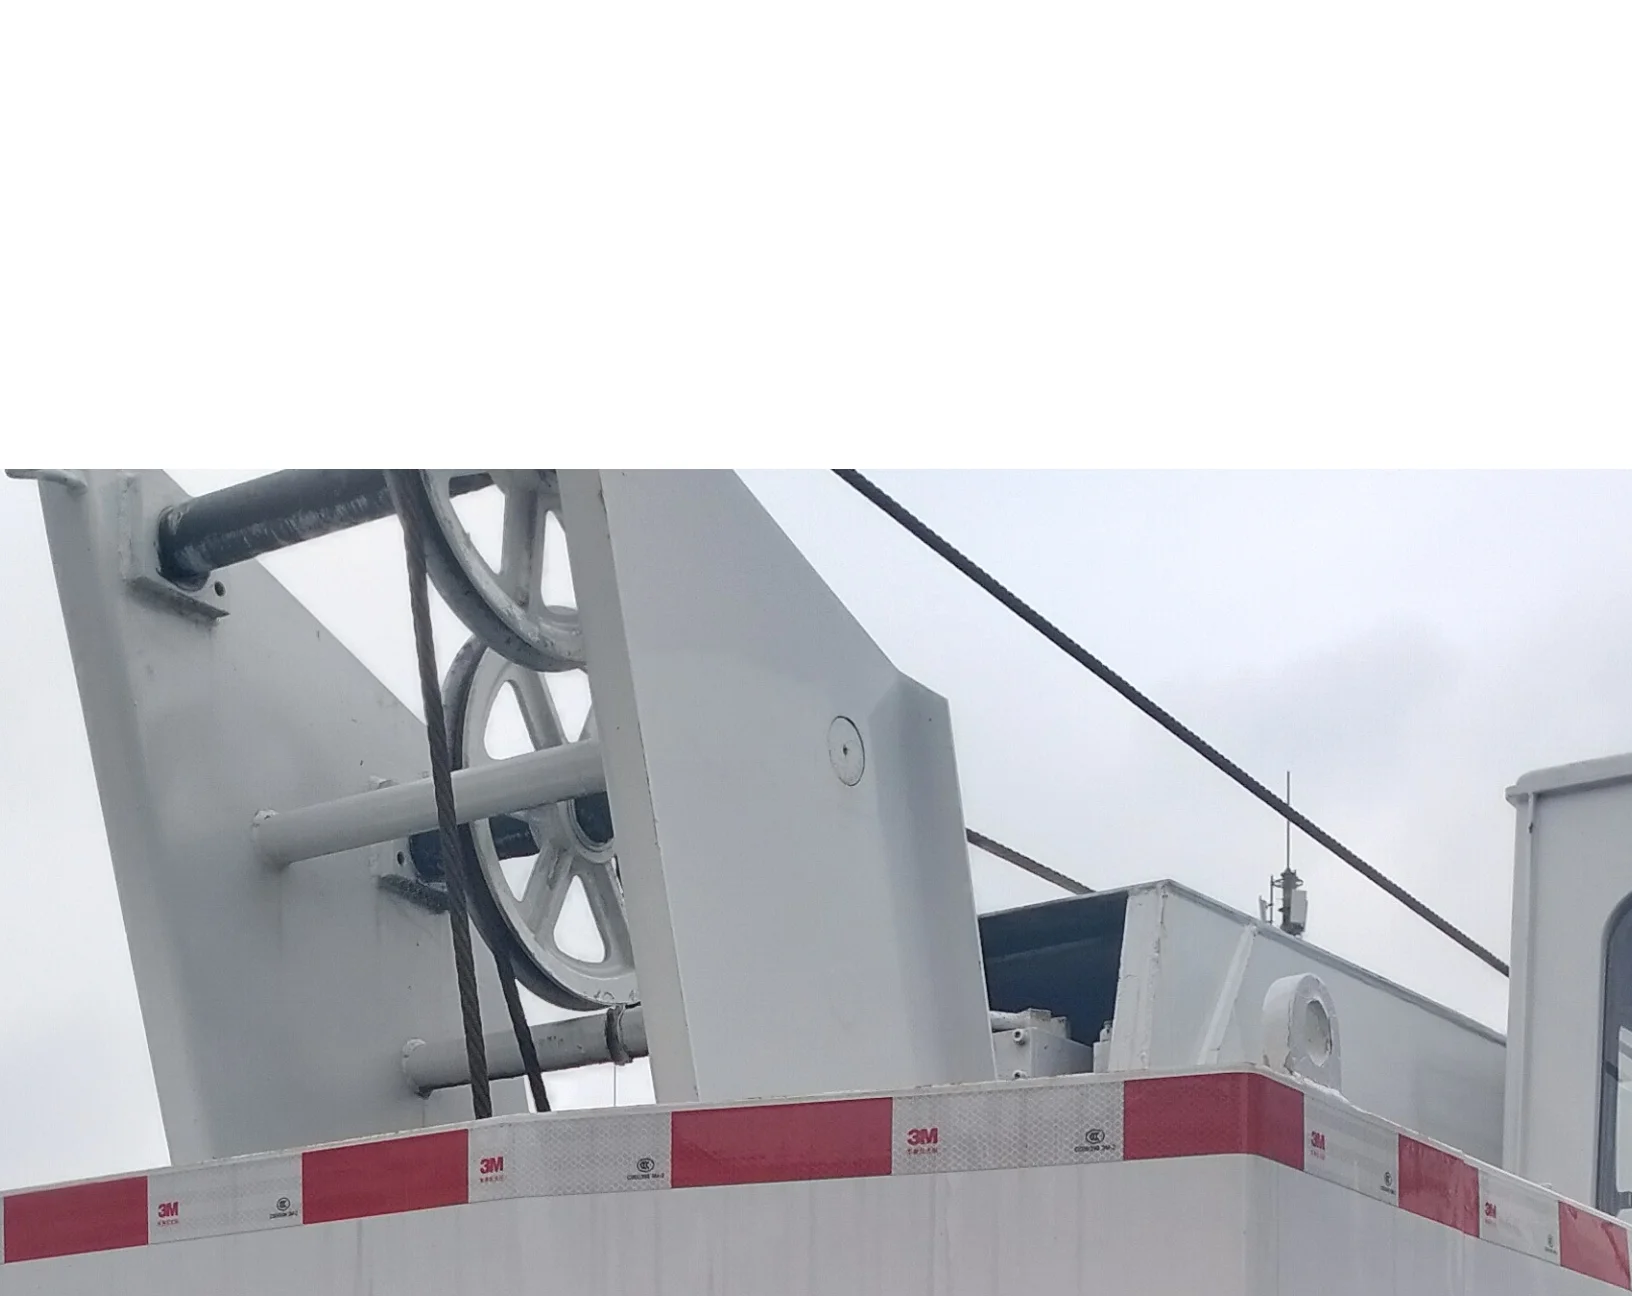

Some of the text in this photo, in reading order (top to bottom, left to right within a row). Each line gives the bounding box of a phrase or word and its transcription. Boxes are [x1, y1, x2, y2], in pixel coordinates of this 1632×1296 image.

[907, 1127, 938, 1146] 3M
[1310, 1130, 1326, 1151] 3M
[479, 1156, 504, 1175] 3M
[158, 1201, 179, 1218] 3M
